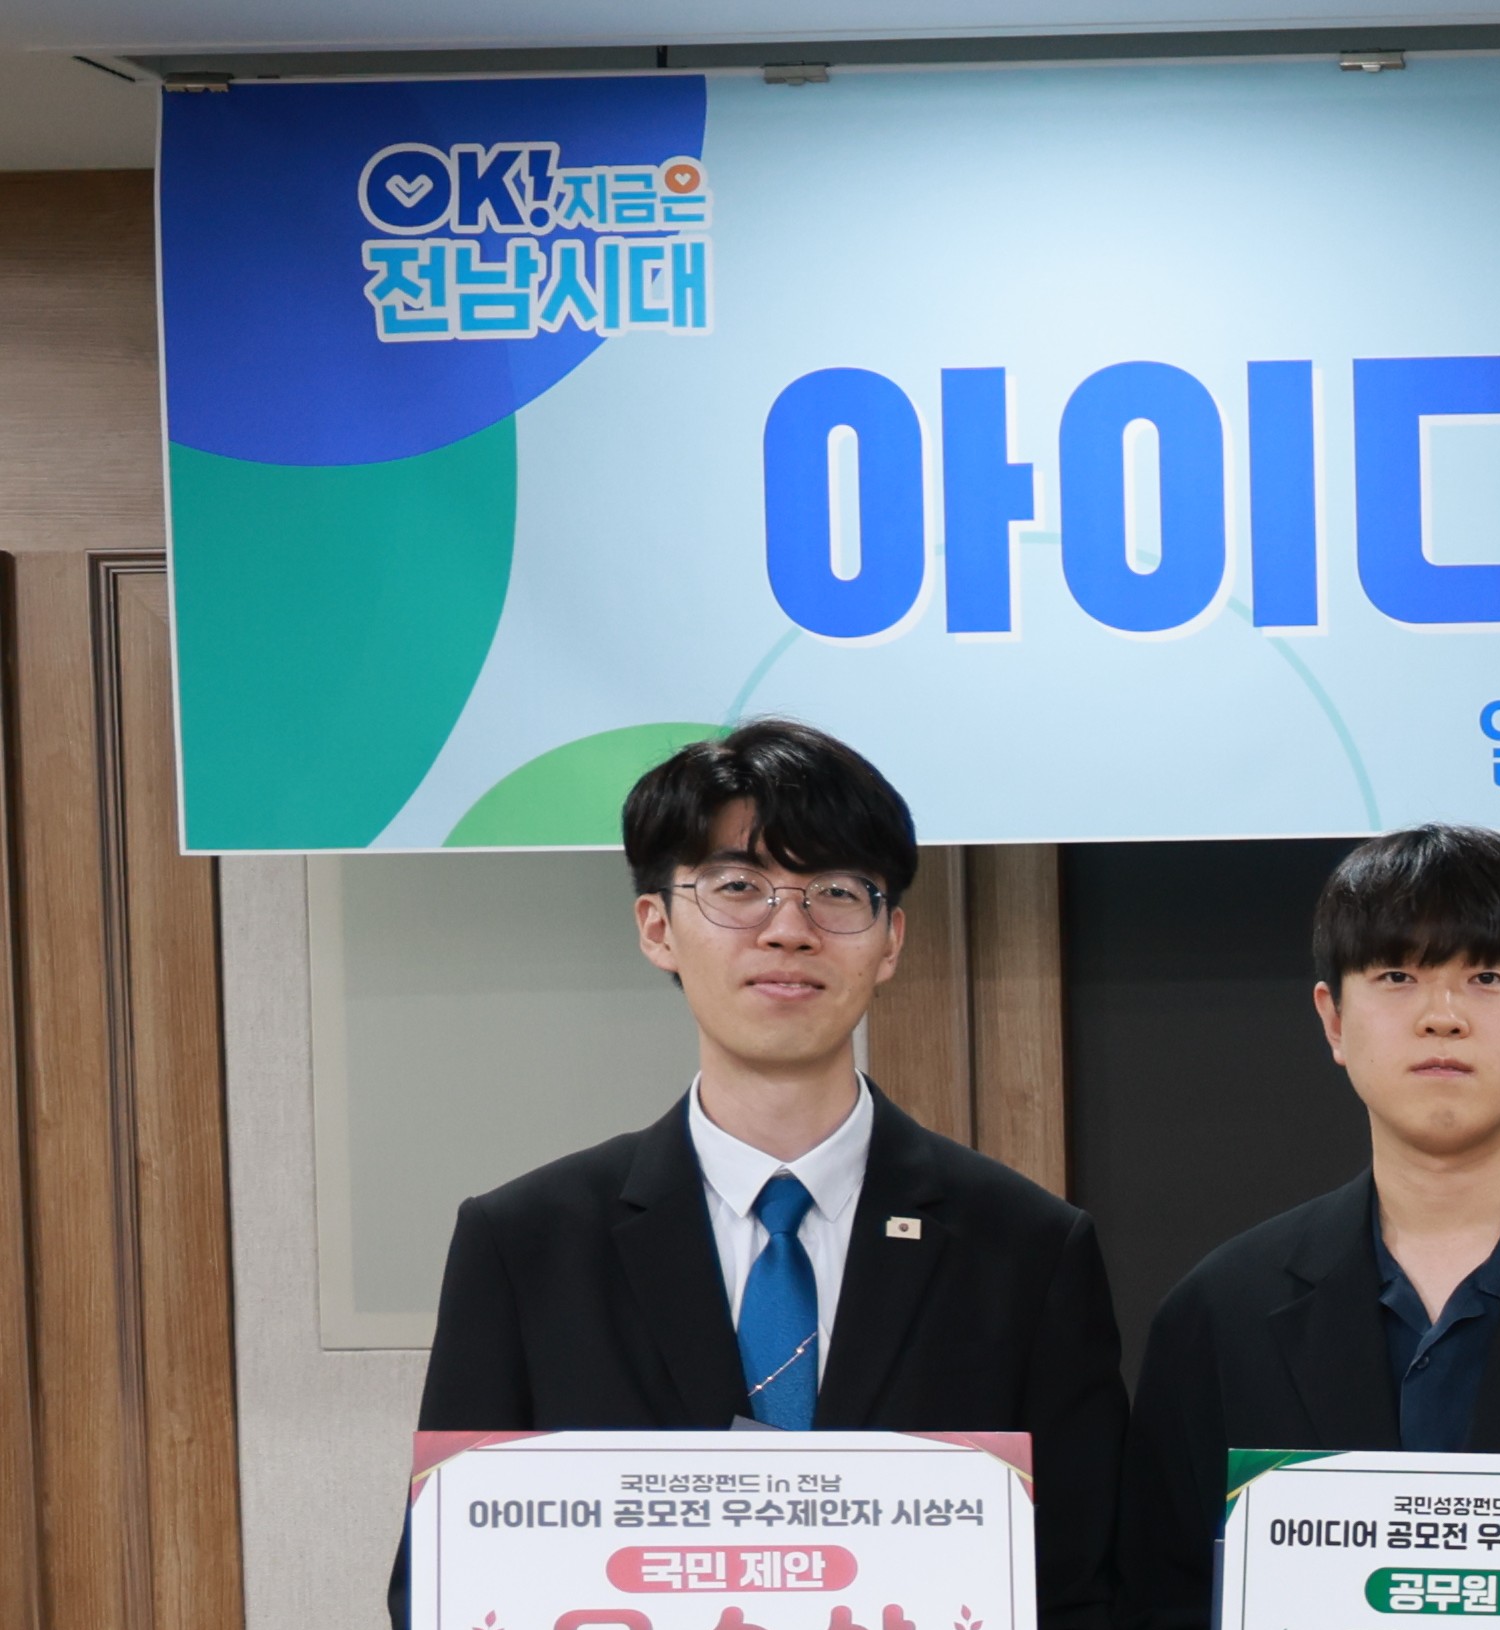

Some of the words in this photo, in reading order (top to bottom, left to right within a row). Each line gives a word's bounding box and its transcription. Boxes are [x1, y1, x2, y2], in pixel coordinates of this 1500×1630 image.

[369, 242, 706, 333] 전남시대
[622, 1475, 759, 1493] 국민성장펀드
[767, 1475, 790, 1492] in
[798, 1475, 841, 1492] 전남
[470, 1500, 601, 1528] 아이디어
[614, 1500, 710, 1527] 공모전
[722, 1499, 882, 1527] 우수제안자
[891, 1499, 983, 1526] 시상식
[1271, 1519, 1376, 1548] 아이디어
[1387, 1522, 1467, 1550] 공모전
[641, 1551, 727, 1589] 국민
[740, 1551, 826, 1588] 제안
[1390, 1574, 1496, 1611] 공무원
